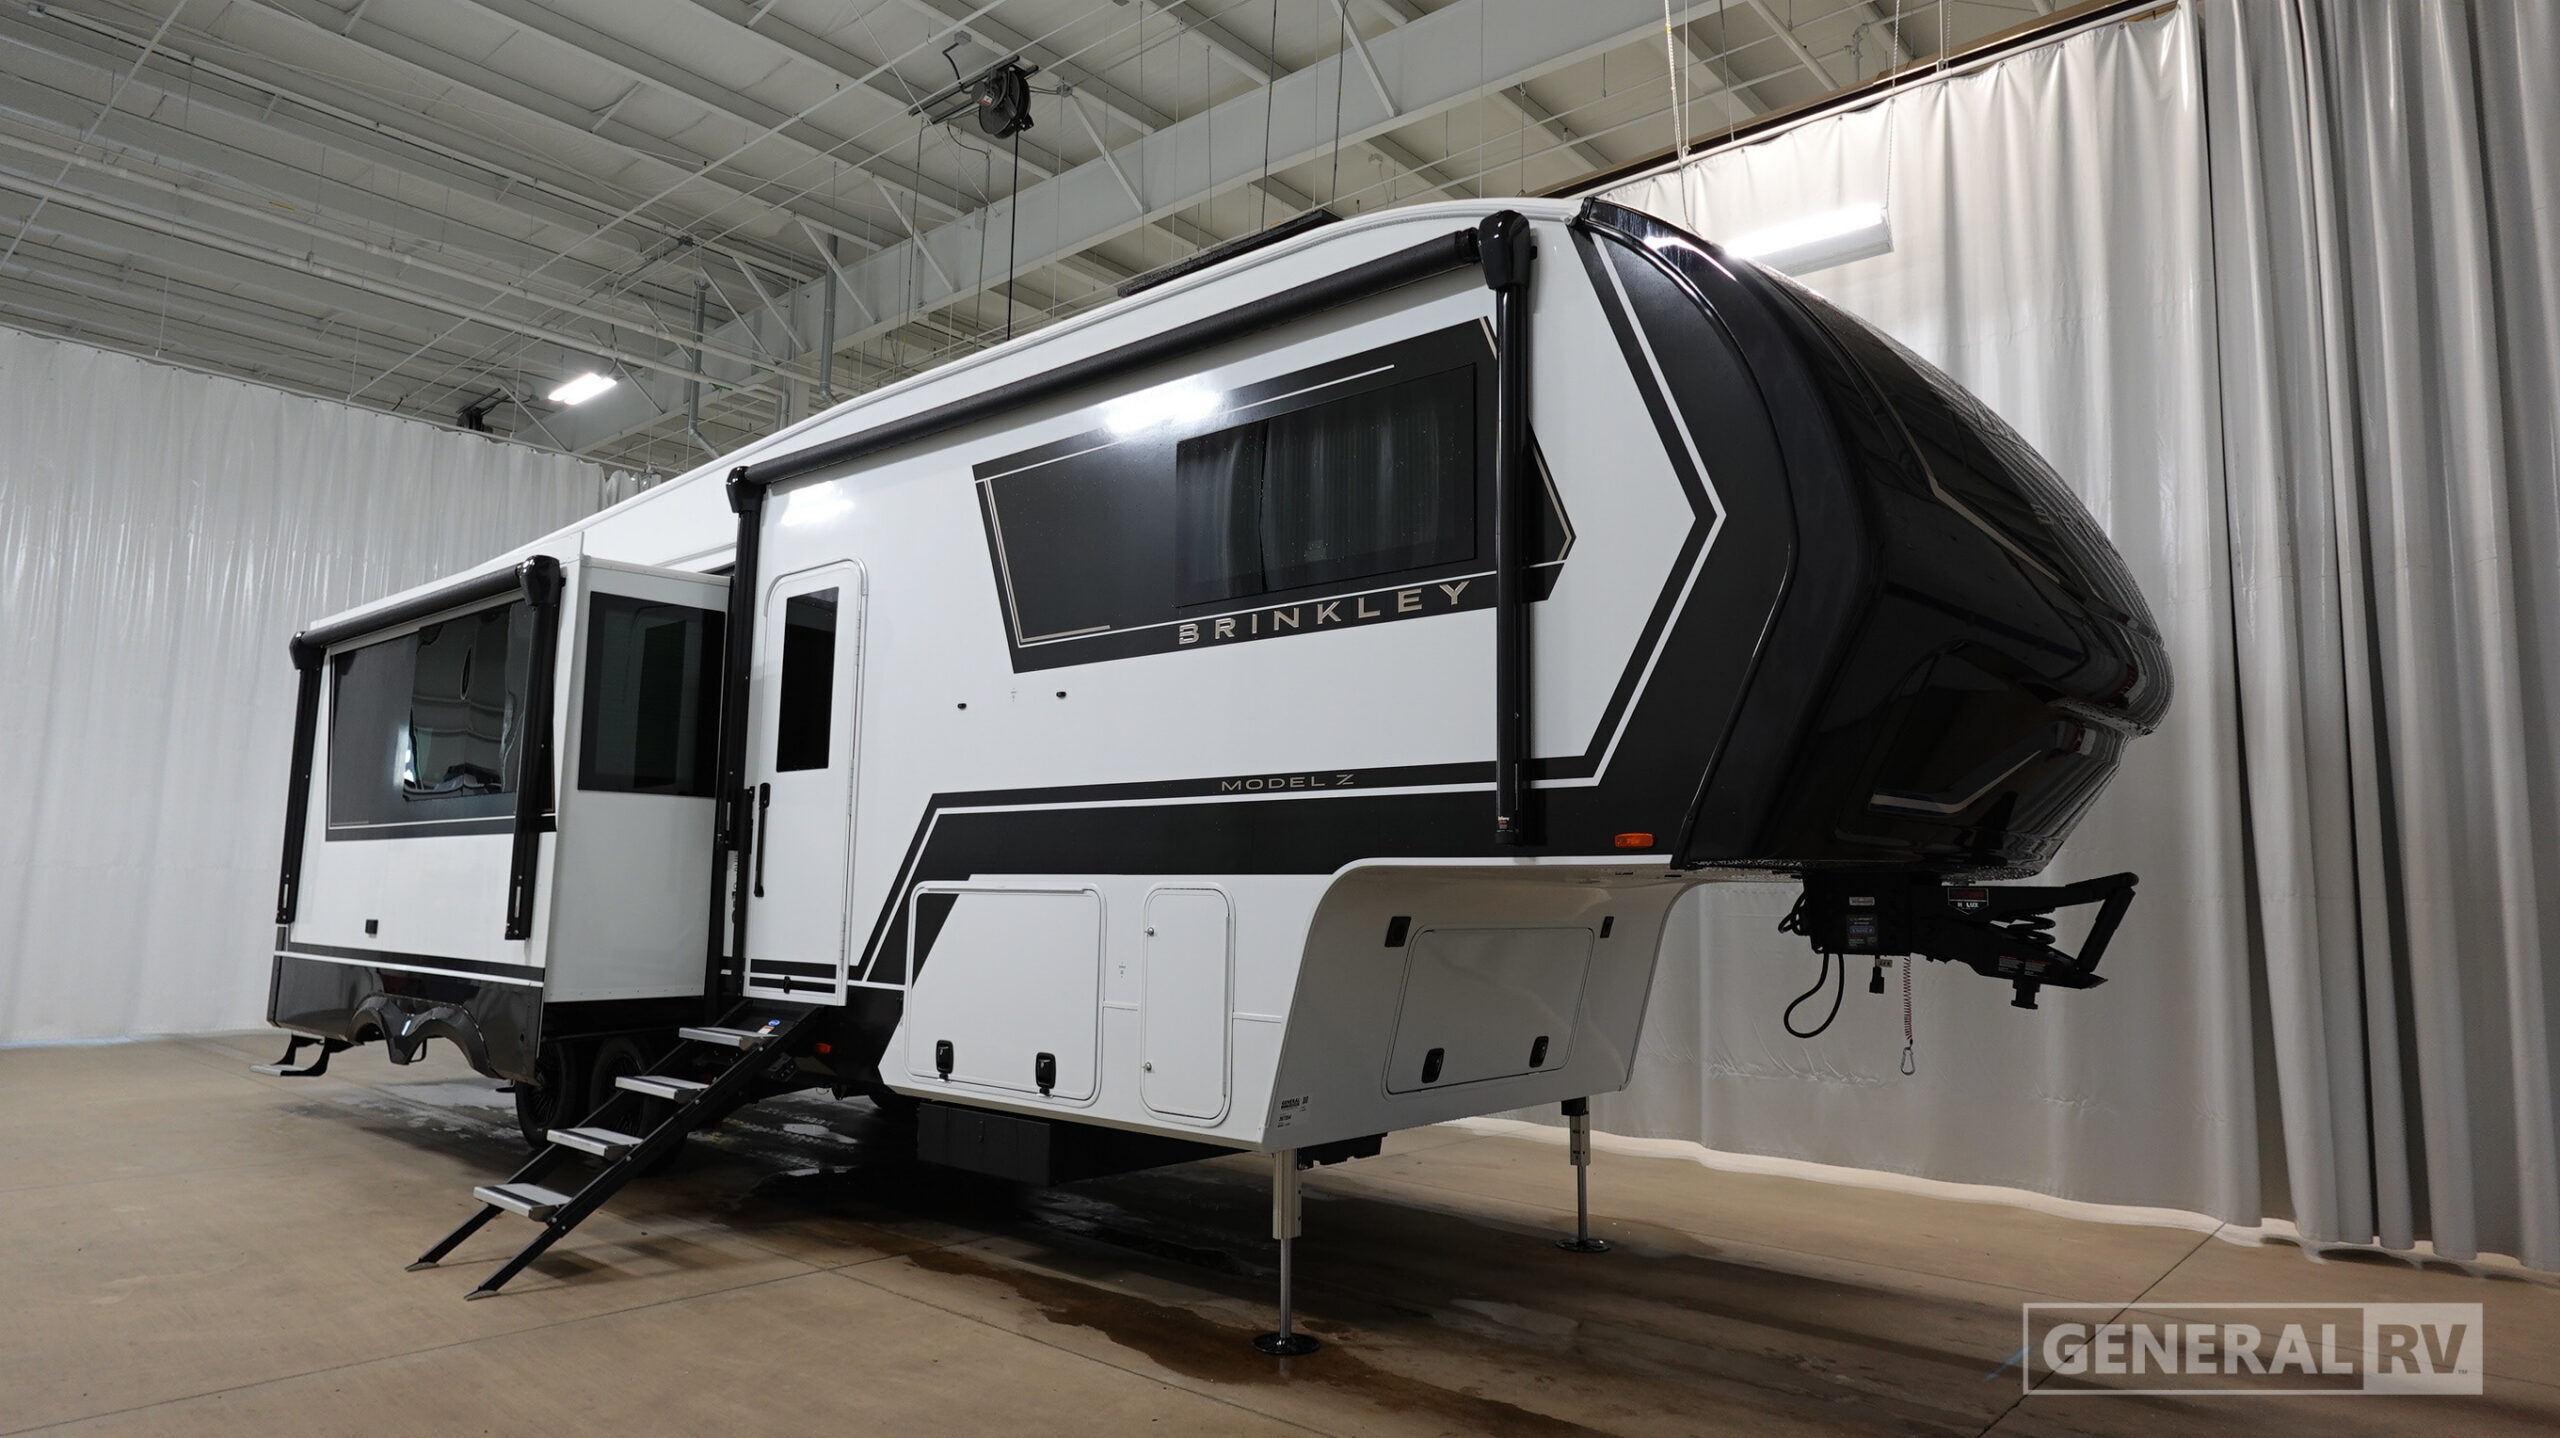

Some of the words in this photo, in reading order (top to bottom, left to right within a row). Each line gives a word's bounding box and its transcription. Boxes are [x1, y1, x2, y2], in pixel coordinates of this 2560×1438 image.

[1179, 580, 1470, 645] BRINKLEY
[1221, 776, 1326, 792] MODEL
[1336, 774, 1354, 786] Z
